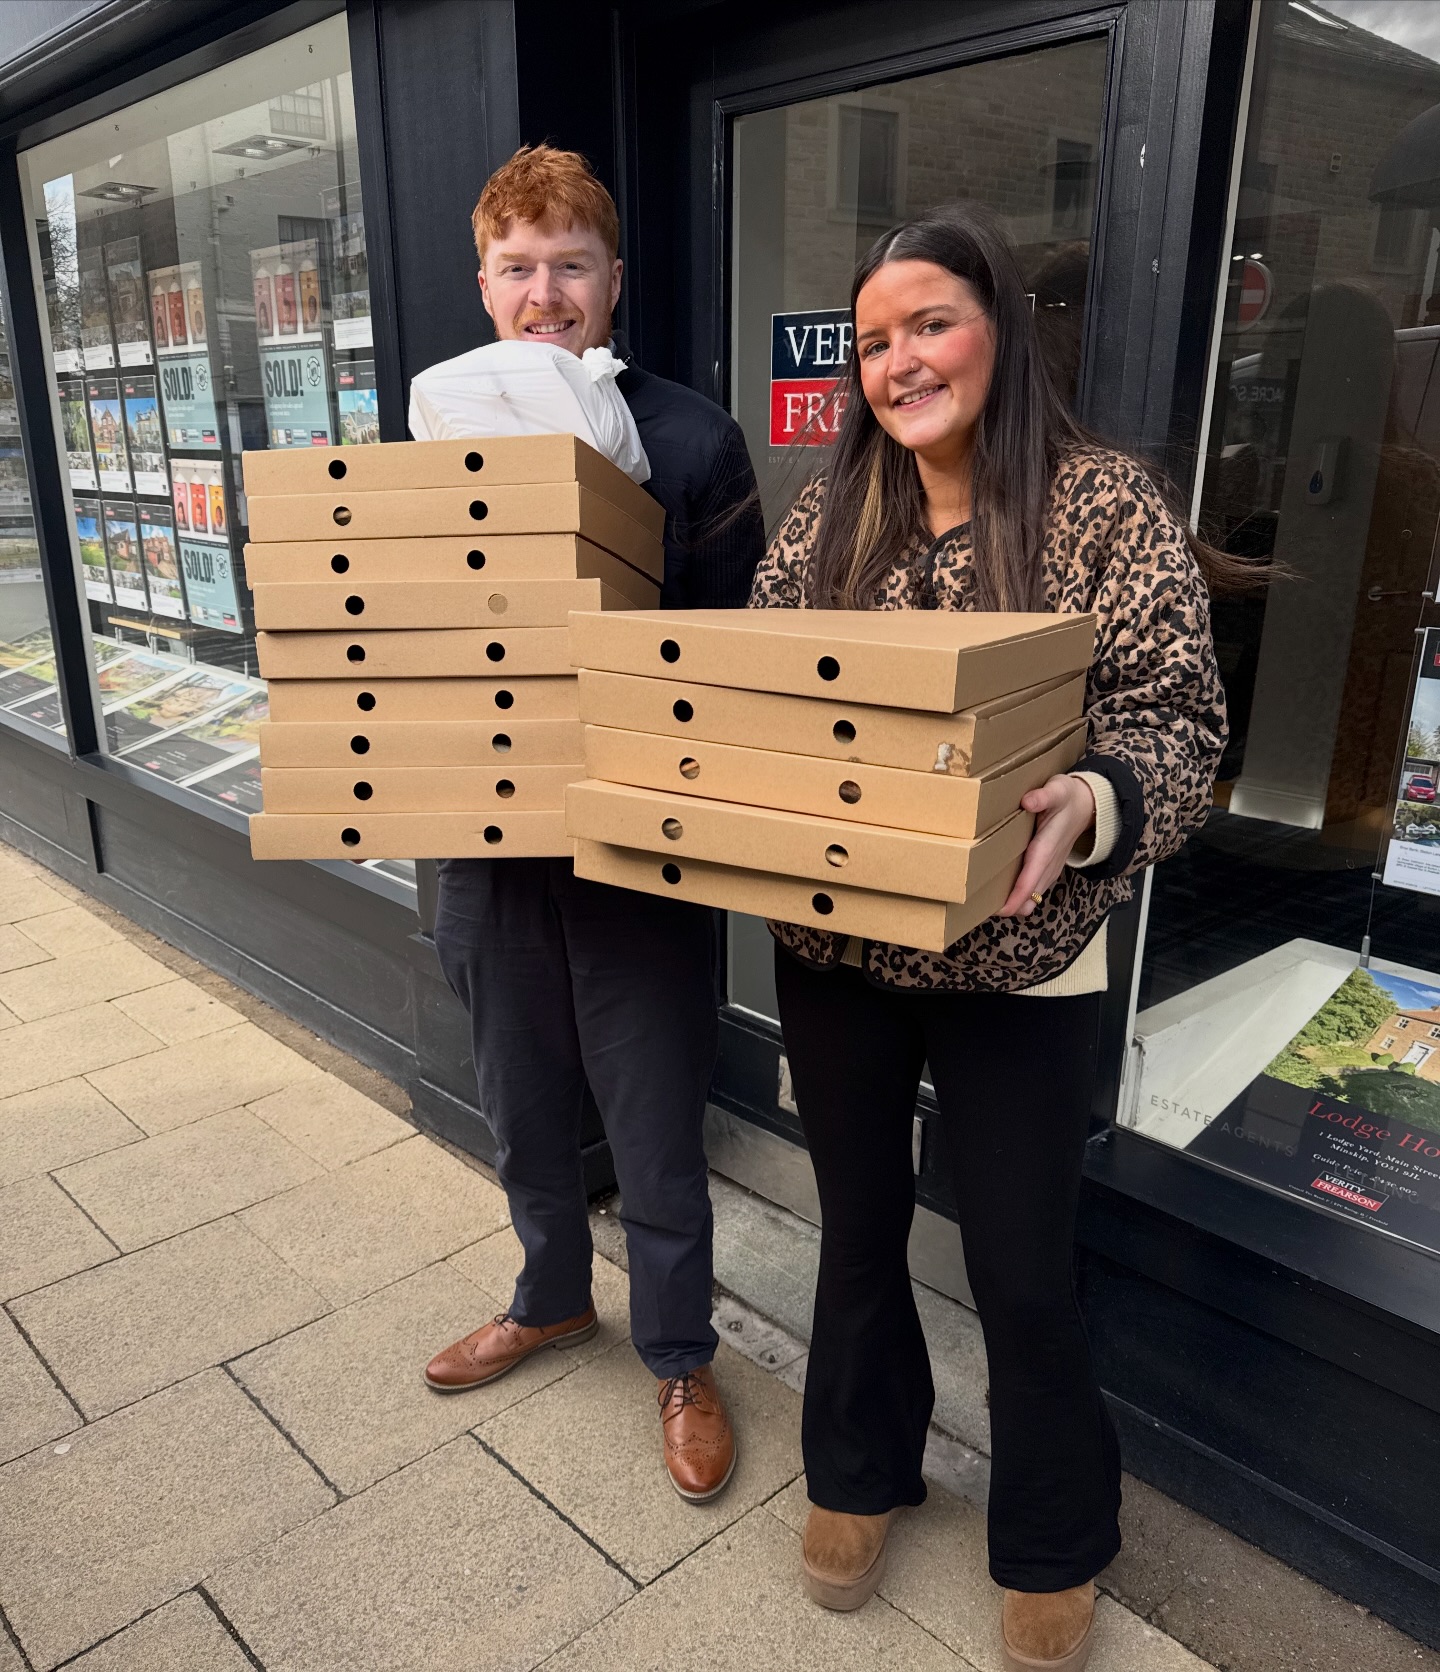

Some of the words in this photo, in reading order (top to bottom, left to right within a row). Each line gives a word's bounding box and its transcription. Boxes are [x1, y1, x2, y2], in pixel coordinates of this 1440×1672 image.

[785, 323, 854, 367] VER
[163, 366, 195, 401] SOLD!
[265, 359, 304, 397] SOLD!
[783, 393, 849, 432] FRE
[184, 549, 215, 584] SOLD!
[1150, 1095, 1212, 1127] ESTATE
[1220, 1122, 1294, 1158] AGENTS
[1308, 1101, 1391, 1140] Lodge
[1326, 1133, 1355, 1148] Lodge
[1385, 1155, 1410, 1168] Main
[1317, 1181, 1376, 1208] FREARSON
[1324, 1174, 1366, 1194] VERITY
